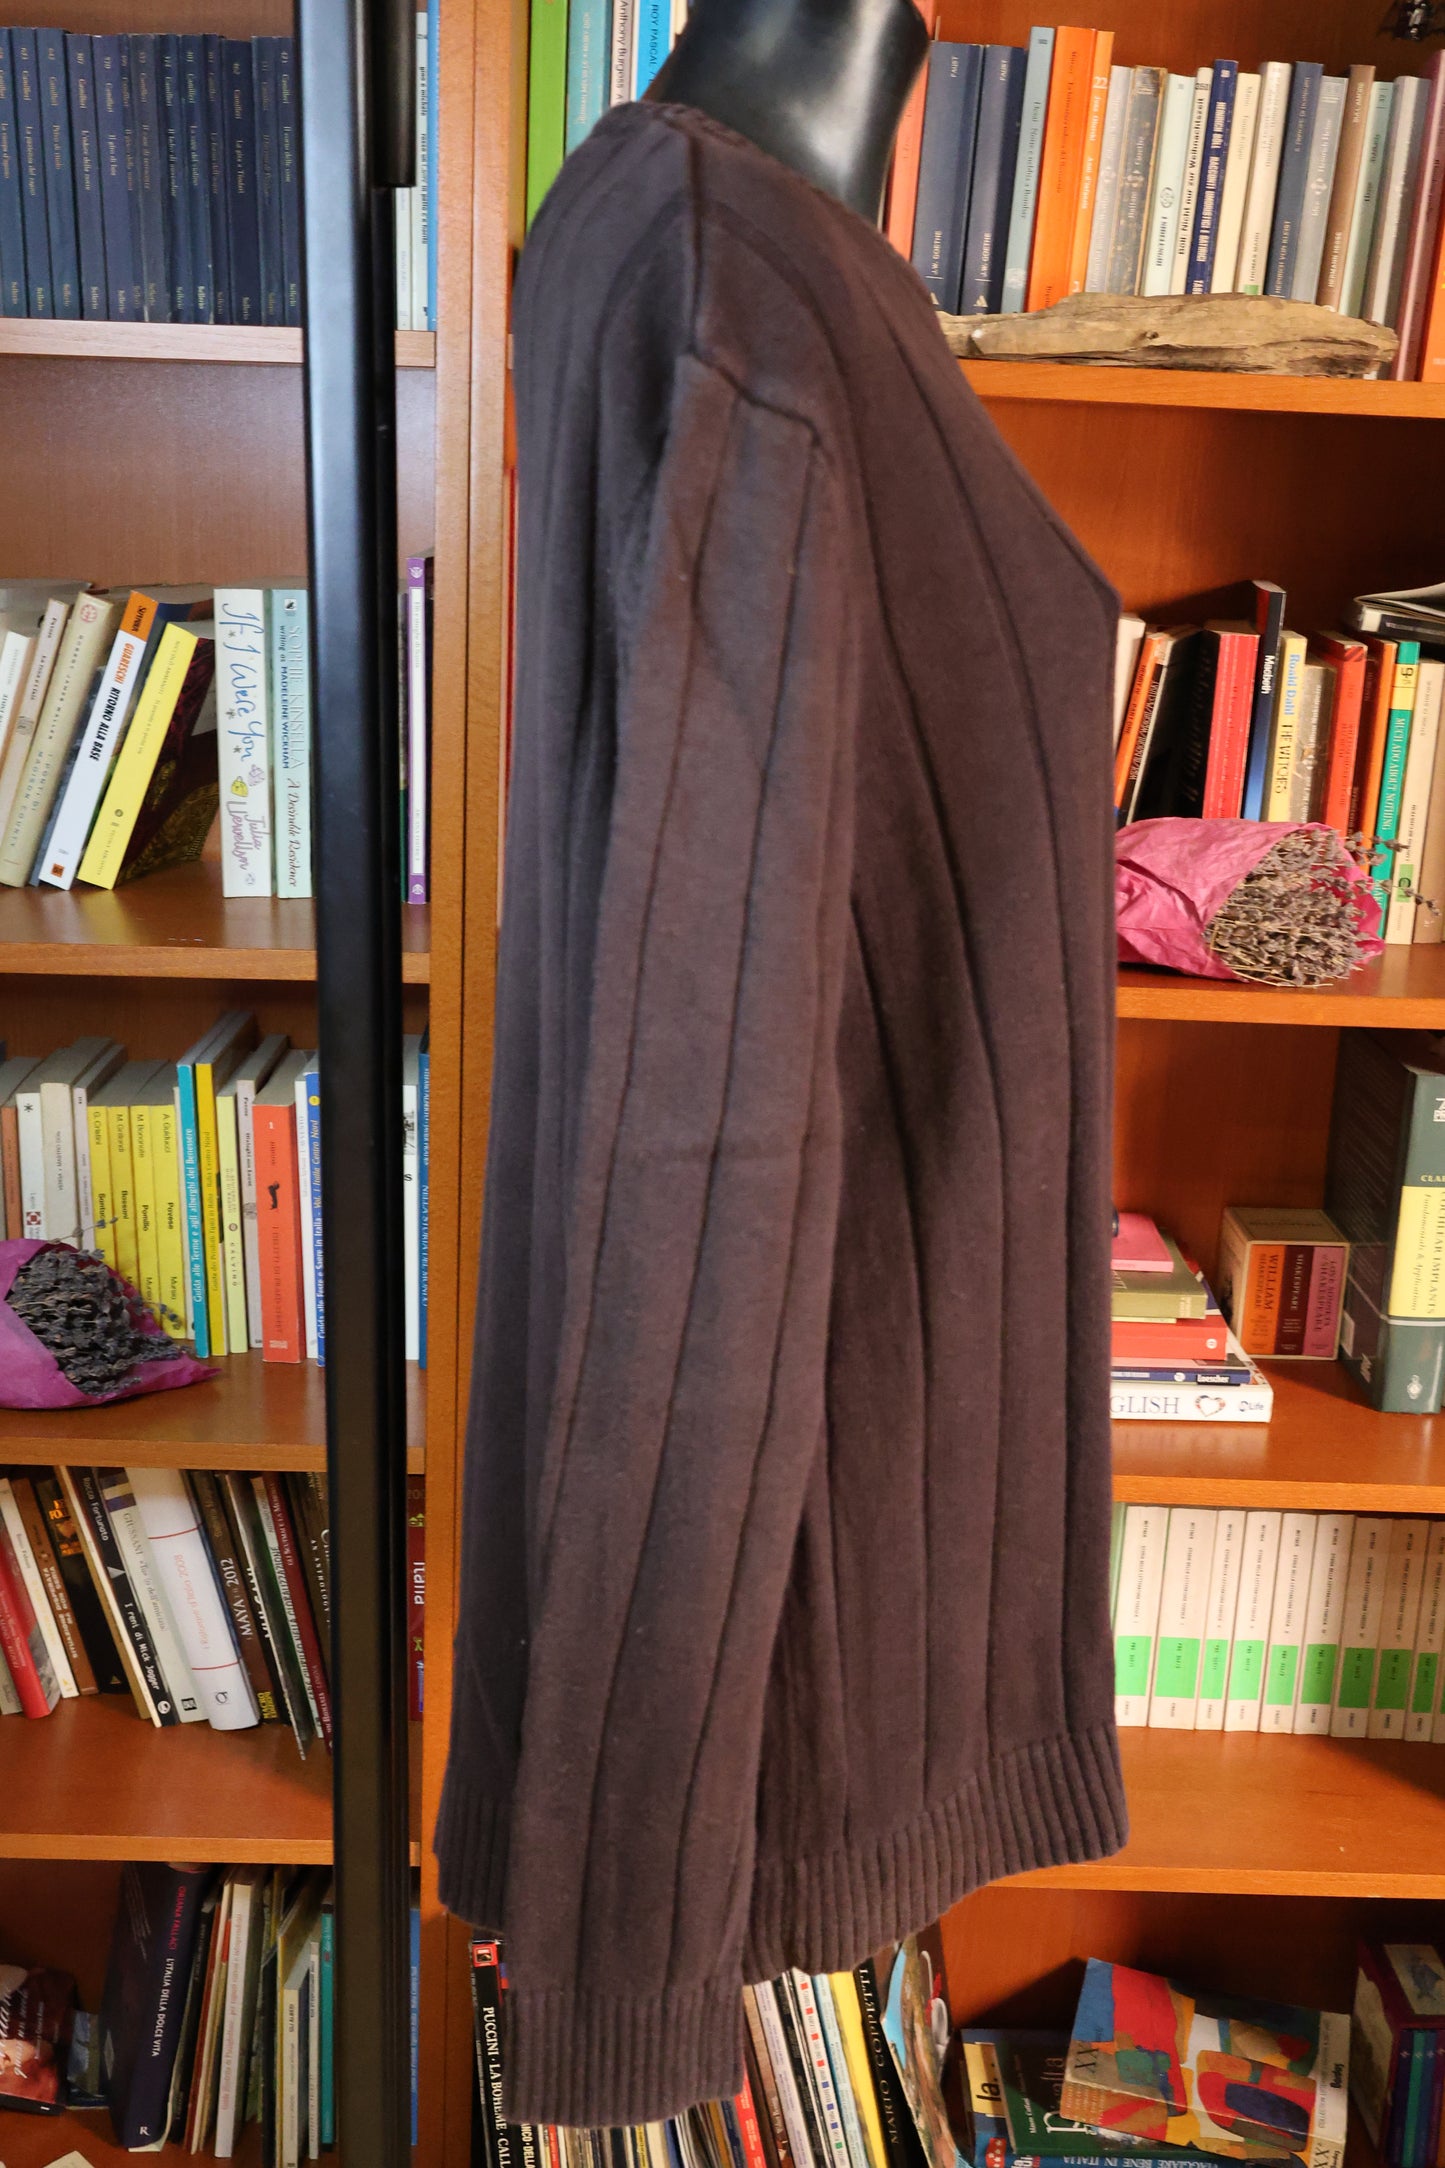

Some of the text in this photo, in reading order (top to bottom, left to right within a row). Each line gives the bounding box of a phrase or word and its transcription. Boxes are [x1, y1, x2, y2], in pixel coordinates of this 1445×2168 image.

[613, 0, 629, 89] Anthony Burgess
[649, 4, 659, 67] ROY PASCAL
[22, 70, 30, 100] Camilleri
[49, 77, 57, 105] Camilleri
[106, 83, 114, 112] Camilleri
[166, 77, 174, 106] Camilleri
[282, 74, 290, 103] Camilleri
[1093, 76, 1107, 90] 22
[234, 90, 242, 118] Camilleri
[932, 55, 959, 275] J.W. GOETHE FAUST
[981, 59, 1009, 278] J.W. GOETHE FAUST
[1180, 207, 1191, 233] Nicht
[1188, 98, 1205, 169] Weihnachtszeit
[1200, 101, 1227, 229] HEINRICH BÖLL RACCONTI UMORISTICI
[78, 79, 99, 309] Camilleri Sellerio
[187, 74, 206, 309] Camilleri Sellerio
[1275, 220, 1291, 294] HEINRICH VON KLEIST
[1327, 231, 1343, 288] HERMANN HESSE
[278, 625, 287, 651] writing
[58, 634, 84, 702] ROBERT JAMES
[218, 603, 265, 762] If I Were You
[1136, 664, 1147, 686] HENRY
[1260, 655, 1275, 694] Macbeth
[89, 643, 134, 762] GUARESCHI RITORNO ALLA BASE
[280, 666, 290, 721] MADELEINE
[289, 625, 305, 769] SOPHIE KINSELLA
[1274, 654, 1300, 794] Roald Dahl THE WITCHES
[281, 722, 290, 769] WICKHAM
[24, 750, 44, 799] MADISON
[30, 762, 52, 813] PONTI DI
[1380, 717, 1405, 830] MUCH ADO ABOUT NOTHING
[9, 805, 27, 848] COUNTY
[226, 801, 250, 871] Llewellyn
[244, 816, 270, 850] Julia
[286, 778, 301, 887] A Desirable Residence
[93, 1111, 103, 1146] G. Cristini
[203, 1131, 211, 1148] Nord
[244, 1132, 252, 1157] Dialoghi
[309, 1120, 318, 1139] Nord
[184, 1128, 195, 1165] Benessere
[204, 1151, 212, 1170] Centro
[311, 1142, 319, 1165] Centro
[137, 1114, 150, 1232] M. Pomilio
[187, 1166, 195, 1178] del
[310, 1167, 319, 1186] Italia
[162, 1113, 179, 1300] A. Guiducci Pavese Mursia
[187, 1181, 200, 1213] alberghi
[312, 1195, 321, 1209] Vol.
[421, 1184, 429, 1213] NELLA
[190, 1214, 201, 1230] agli
[313, 1217, 321, 1237] Italia
[421, 1216, 429, 1249] STORIA
[1417, 1193, 1432, 1250] Fundamentals
[191, 1238, 200, 1261] Terme
[209, 1236, 217, 1261] Prodotti
[314, 1249, 324, 1271] Sagre
[192, 1263, 201, 1277] alle
[210, 1273, 219, 1291] Guida
[1264, 1254, 1278, 1310] WILLIAM
[1290, 1254, 1304, 1311] SHAKESPEARE
[1328, 1261, 1337, 1283] LOVE
[1410, 1261, 1423, 1311] Applications
[1427, 1252, 1441, 1314] IMPLANTS
[194, 1280, 203, 1303] Guida
[315, 1279, 324, 1297] Feste
[1314, 1260, 1329, 1331] SHAKESPEARE
[316, 1299, 324, 1313] alle
[315, 1315, 325, 1340] Guida
[1249, 1402, 1264, 1410] Life
[82, 1477, 95, 1500] Rocco
[89, 1502, 109, 1541] Fortunato
[123, 1513, 143, 1556] GIUSSANI
[48, 1566, 63, 1589] SERIA
[174, 1554, 189, 1578] 2008
[43, 1567, 65, 1611] DISPERATA
[220, 1557, 253, 1636] MAYA 2012
[313, 1556, 330, 1612] ANTHOLOGY
[124, 1611, 139, 1629] reni
[133, 1632, 144, 1641] di
[138, 1643, 151, 1662] Mick
[144, 1665, 160, 1690] Jagger
[257, 1692, 269, 1719] MACRO
[151, 1886, 186, 2056] ORIANA FALLACI L'ITALIA DELLA DOLCE VITA
[483, 2006, 509, 2131] PUCCINI LA BOHEME
[880, 2079, 899, 2145] MARIO
[1063, 2155, 1099, 2166] ITALIA
[1104, 2157, 1118, 2167] IN
